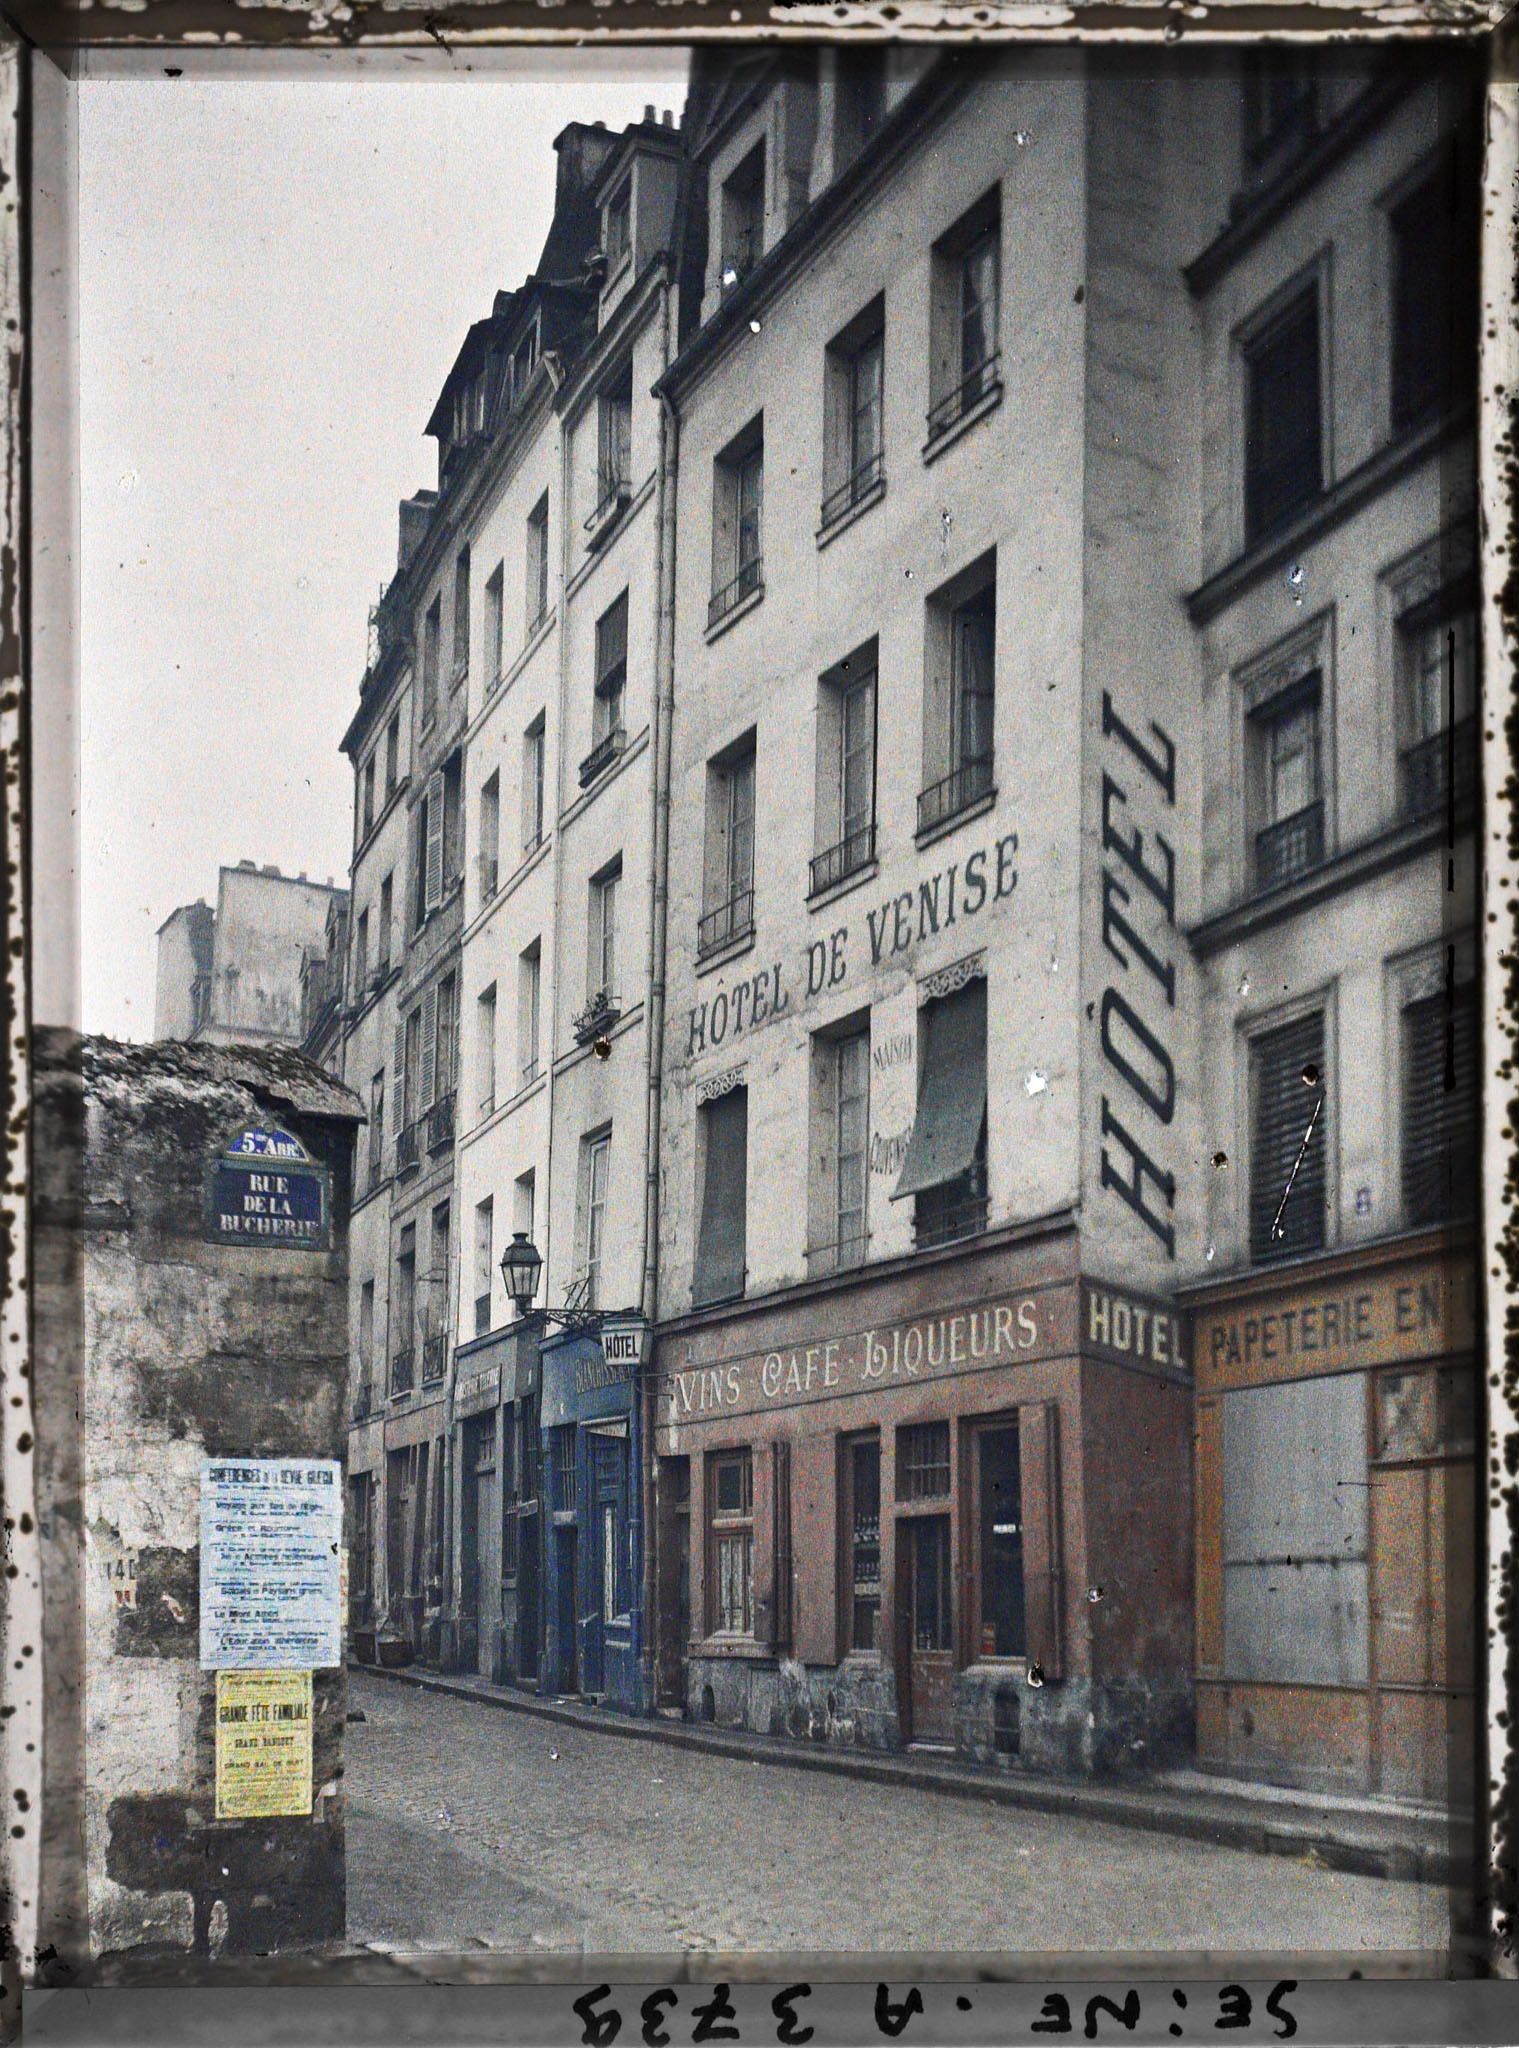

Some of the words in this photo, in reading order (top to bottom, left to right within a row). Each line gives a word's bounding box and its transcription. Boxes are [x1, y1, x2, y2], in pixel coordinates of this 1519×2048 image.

[687, 962, 789, 1058] HÔTEL
[806, 927, 848, 1000] DE
[866, 832, 1019, 966] VENISE
[243, 1195, 267, 1213] DE
[269, 1197, 293, 1216] LA
[250, 1174, 289, 1194] RUE
[605, 1333, 639, 1359] HÔTEL
[1211, 1295, 1374, 1367] PAPETERIE
[674, 1366, 741, 1413] VINS
[862, 1300, 1038, 1380] LIQUEURS
